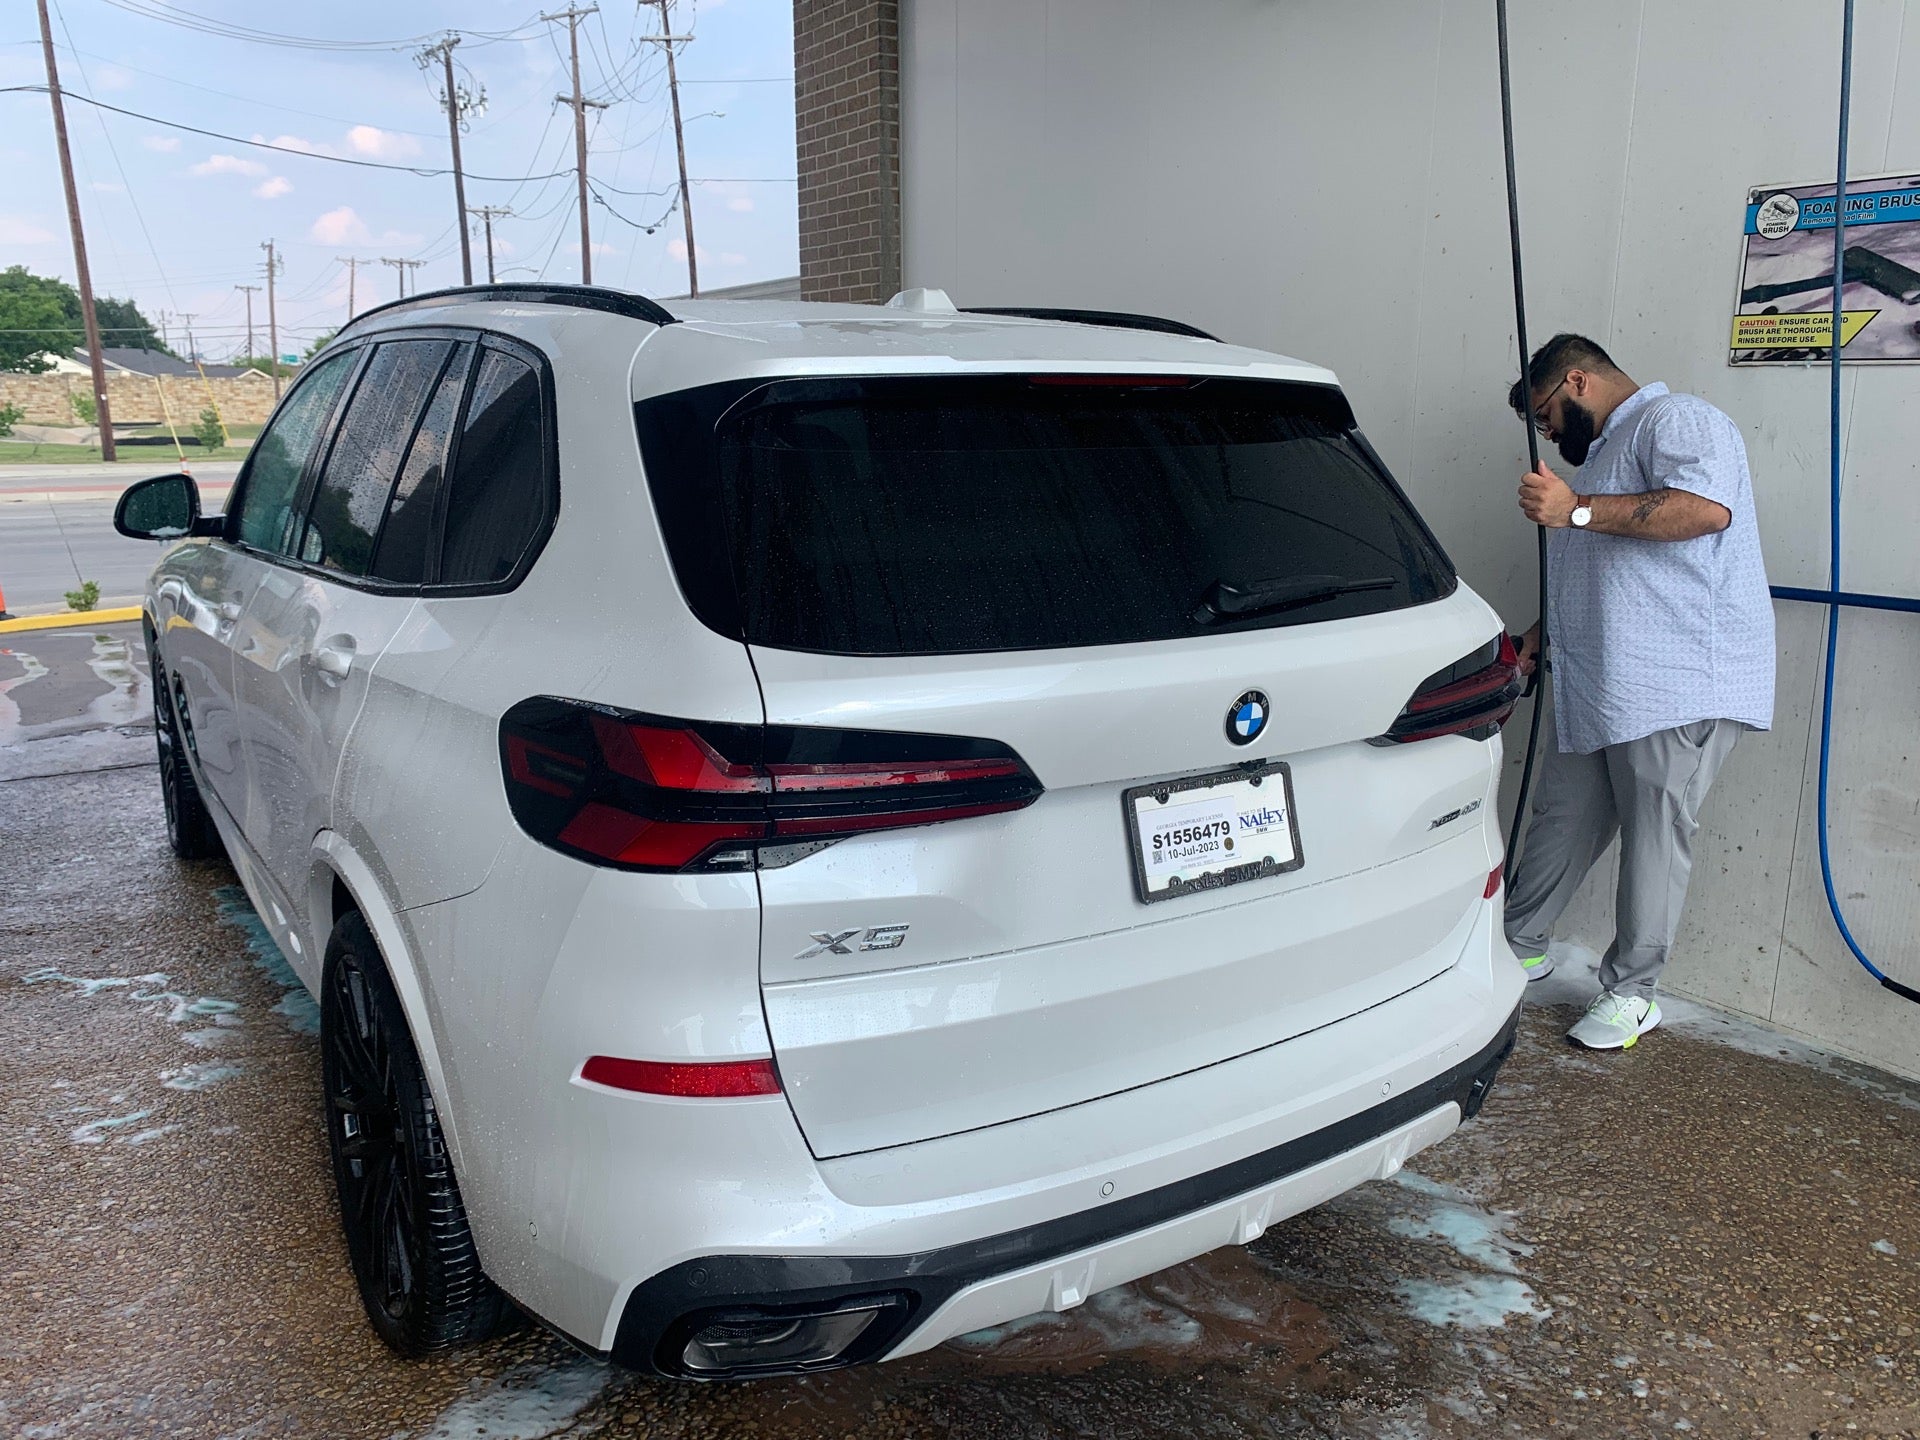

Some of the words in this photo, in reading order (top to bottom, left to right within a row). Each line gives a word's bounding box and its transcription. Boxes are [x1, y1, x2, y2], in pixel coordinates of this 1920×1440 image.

[1803, 197, 1874, 215] FOAING
[1802, 216, 1835, 224] Removes
[1762, 226, 1790, 234] BRUSH
[1739, 319, 1777, 327] CAUTION:
[1783, 326, 1833, 334] THOROUGHL
[1232, 691, 1268, 712] BMW
[1238, 807, 1286, 829] NALLEY
[1152, 820, 1231, 849] S1556479
[1168, 840, 1220, 859] 10-Jul-2023
[793, 922, 910, 960] X5
